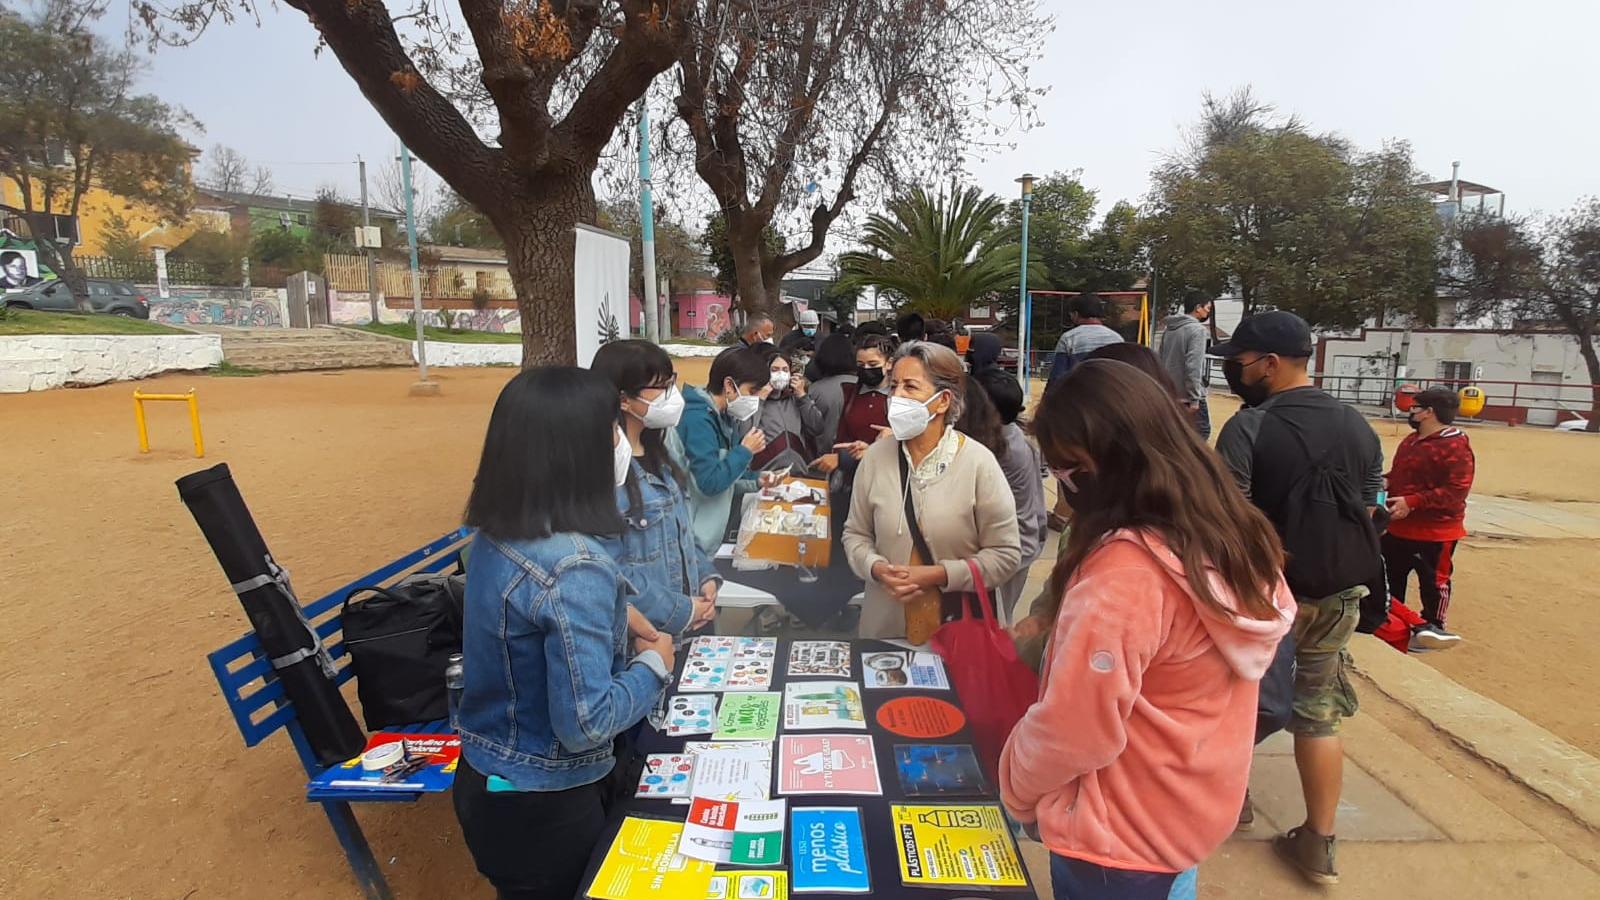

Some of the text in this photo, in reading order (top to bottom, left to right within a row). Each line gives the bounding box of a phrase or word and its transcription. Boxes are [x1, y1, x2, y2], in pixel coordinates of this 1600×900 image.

[809, 822, 827, 873] menos
[825, 821, 863, 874] plástico
[906, 839, 922, 877] PLÁSTICOS
